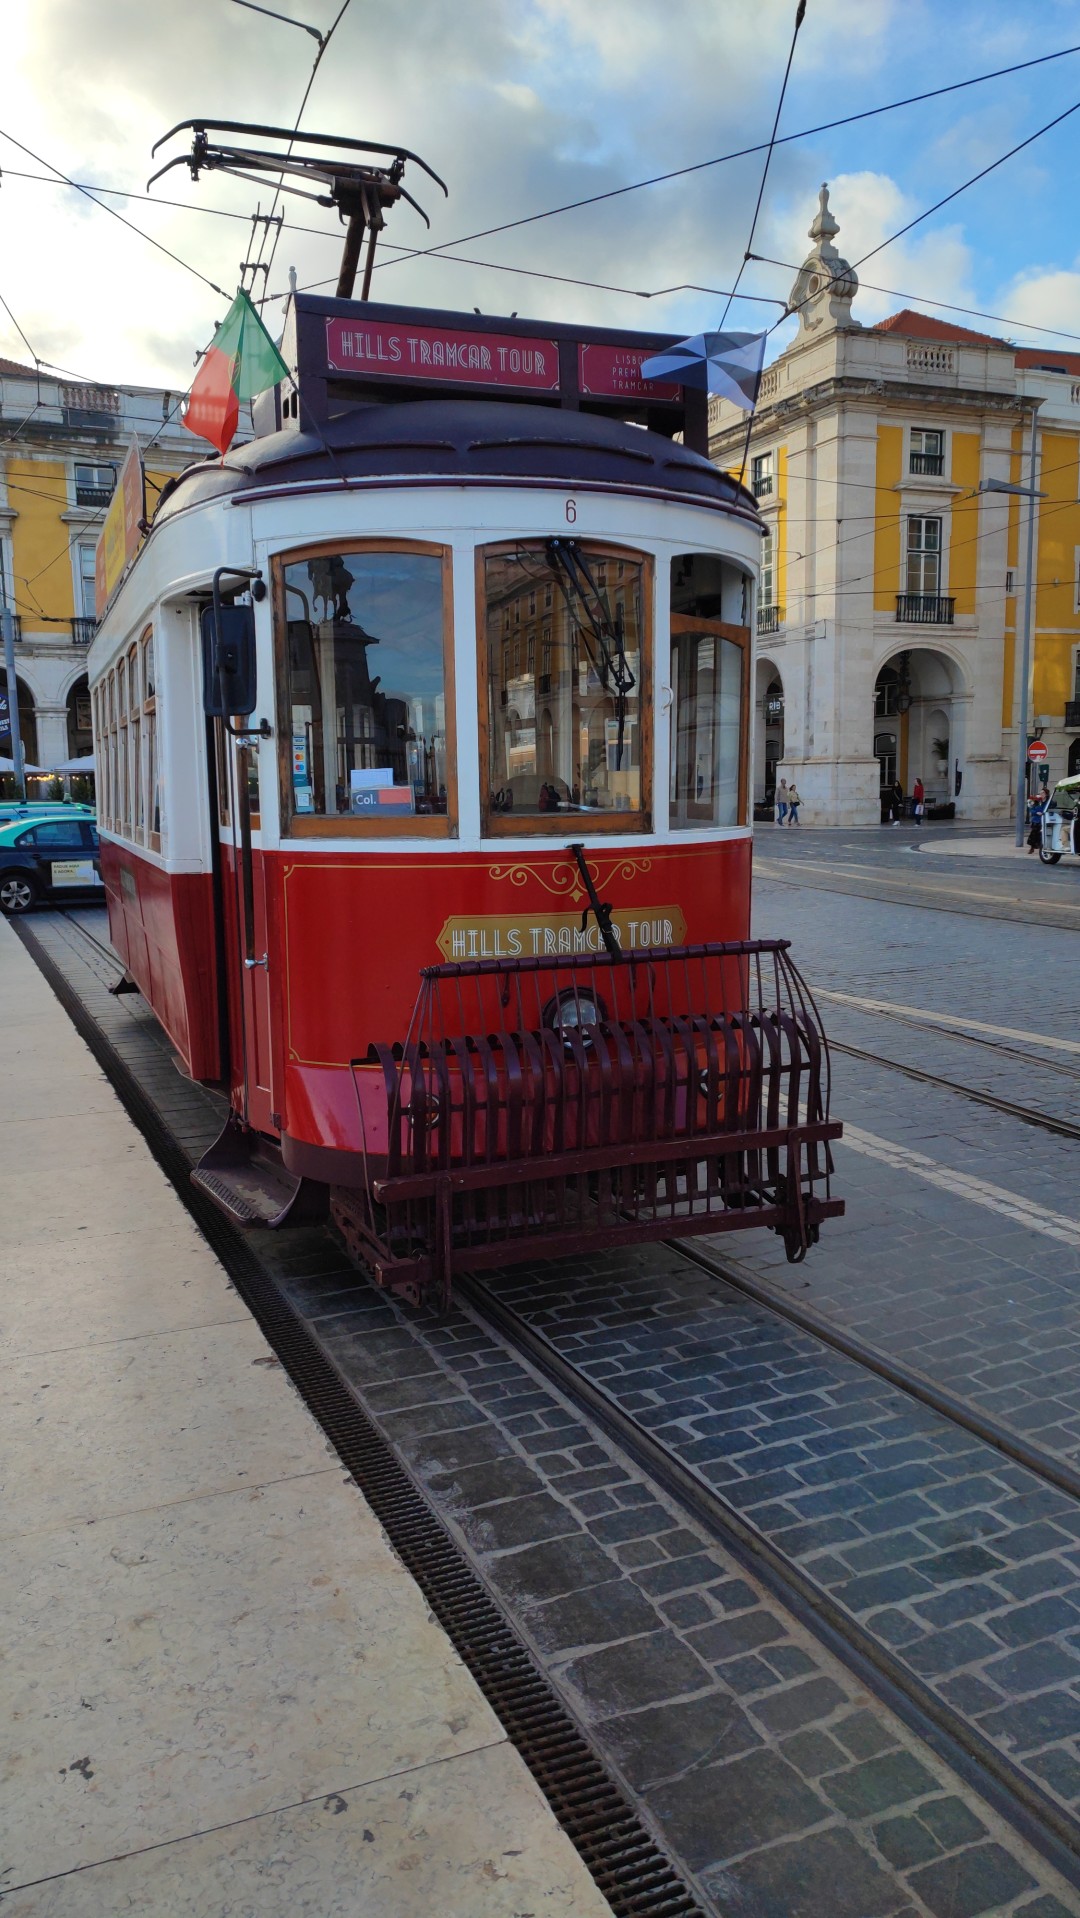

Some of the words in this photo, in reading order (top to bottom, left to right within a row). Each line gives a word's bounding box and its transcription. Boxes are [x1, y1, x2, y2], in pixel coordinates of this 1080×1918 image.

[341, 331, 402, 361] HILLS
[406, 337, 492, 371] TRAMCAR
[497, 346, 546, 376] TOUR
[612, 379, 655, 391] TRAMCAR
[565, 499, 577, 524] 6
[356, 793, 377, 805] Col.
[452, 928, 522, 957] HILLS
[529, 923, 622, 954] TRAMCAR
[627, 919, 674, 948] TOUR
